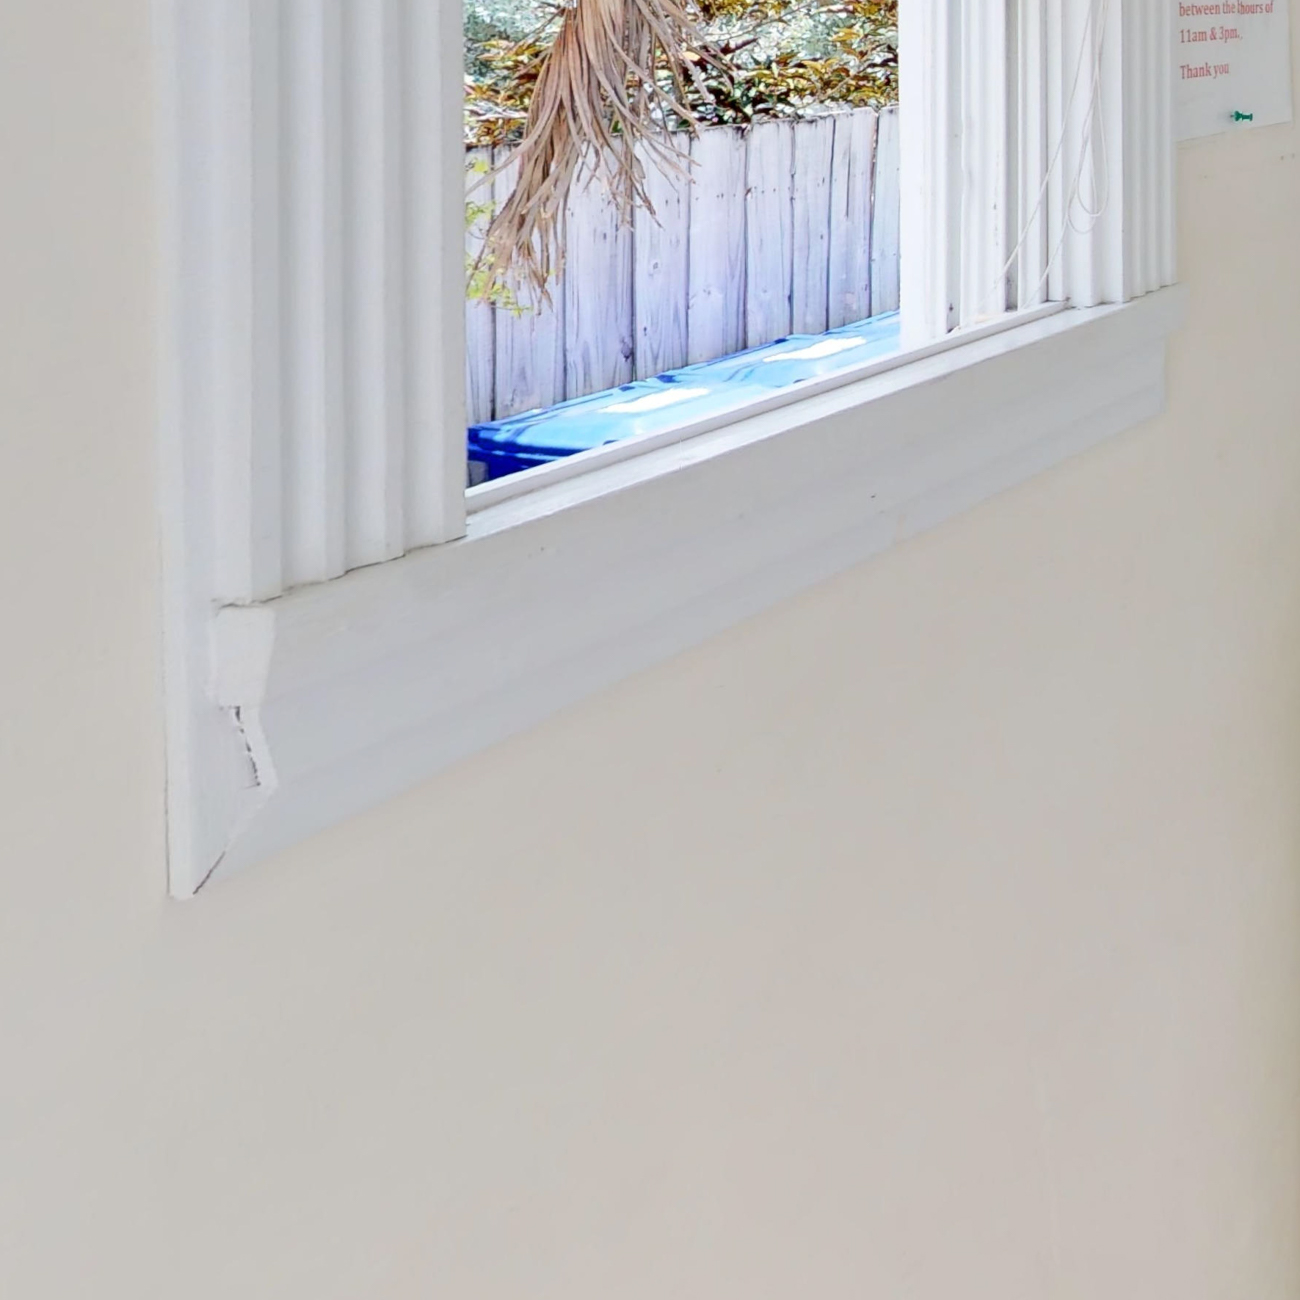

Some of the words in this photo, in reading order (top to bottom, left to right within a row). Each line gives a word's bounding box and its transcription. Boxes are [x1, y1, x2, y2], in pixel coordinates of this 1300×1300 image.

[1179, 2, 1220, 17] between
[1222, 0, 1235, 14] the
[1265, 0, 1274, 13] of
[1180, 28, 1207, 44] 11am
[1209, 27, 1217, 40] &
[1179, 62, 1212, 80] Thank
[1213, 62, 1229, 79] you
